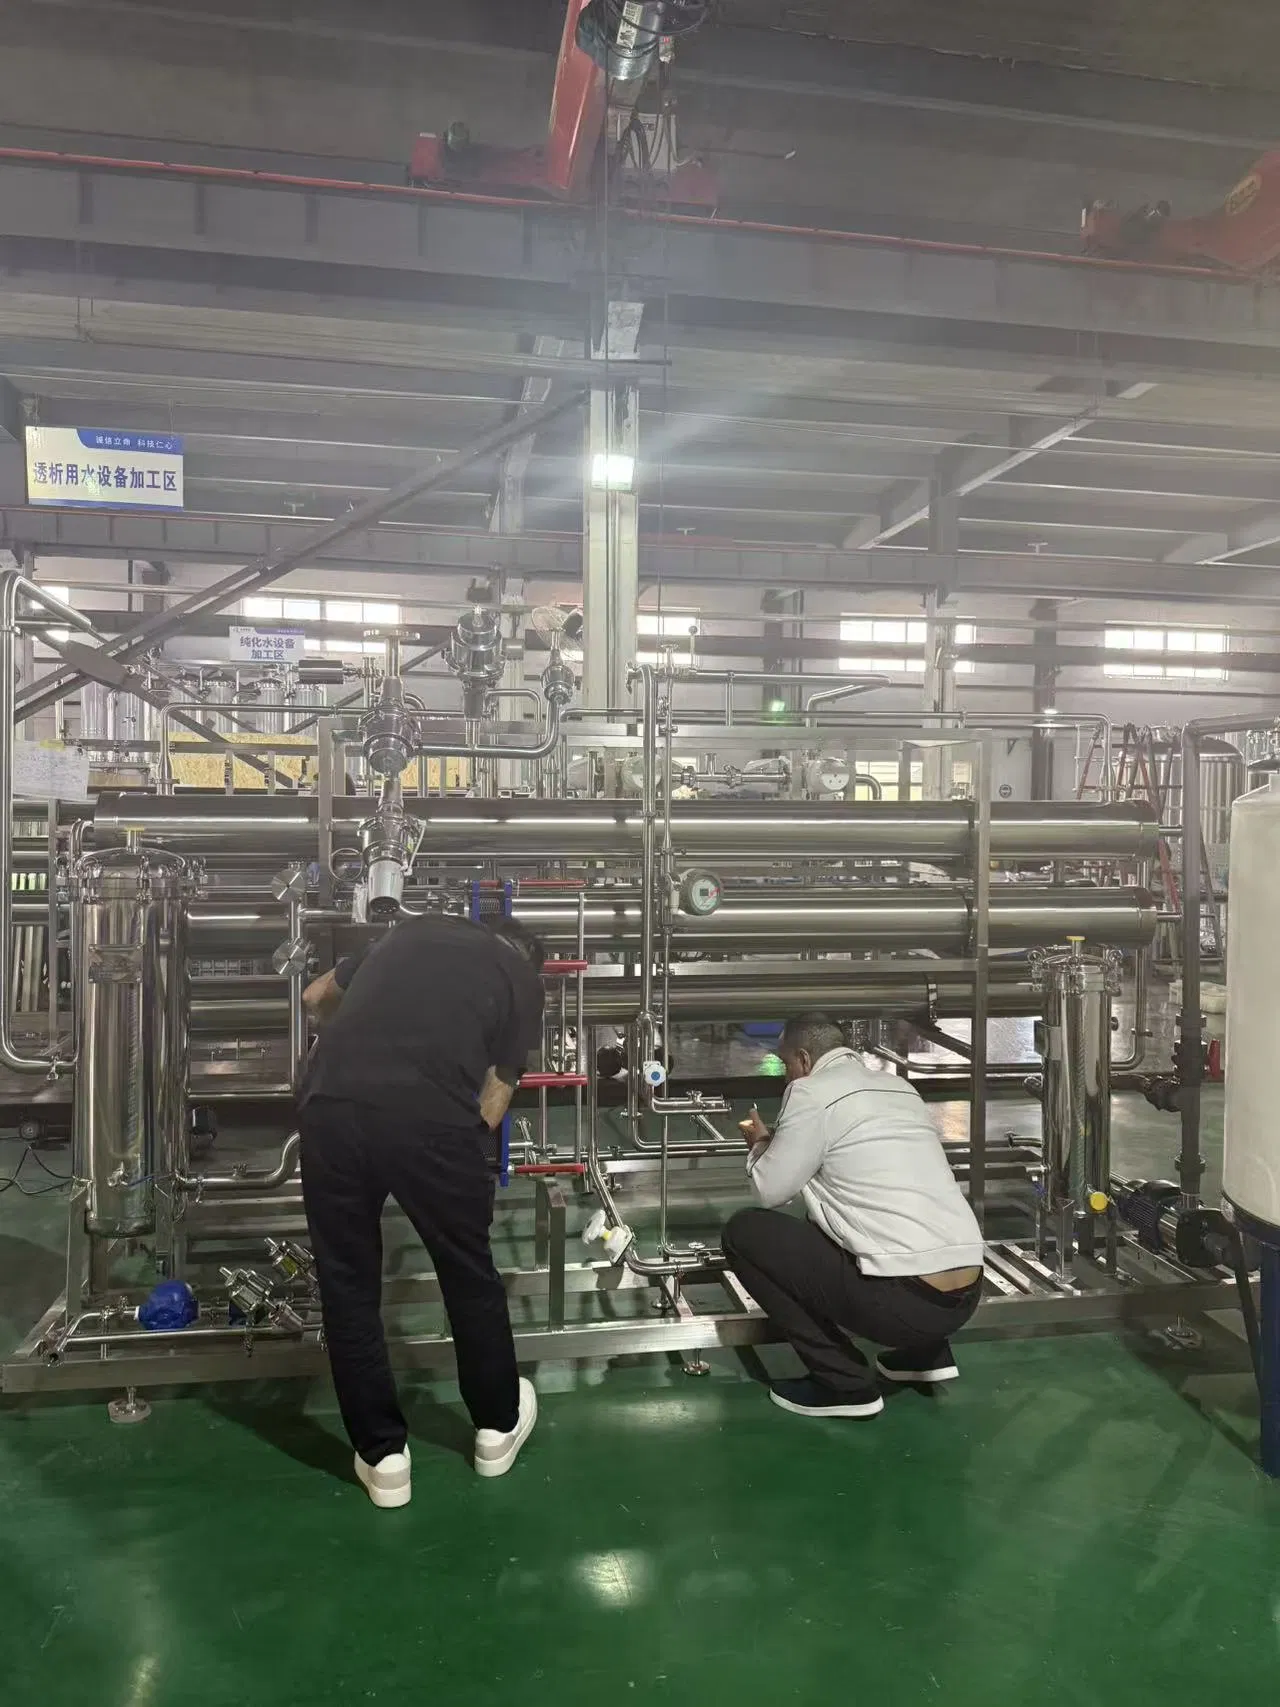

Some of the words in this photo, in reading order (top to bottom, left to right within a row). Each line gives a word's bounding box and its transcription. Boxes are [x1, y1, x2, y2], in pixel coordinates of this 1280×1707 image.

[137, 438, 173, 450] 科技仁心
[33, 461, 177, 492] 透析用水设备加工区
[240, 636, 295, 649] 纯化水设备
[251, 649, 285, 660] 加工区
